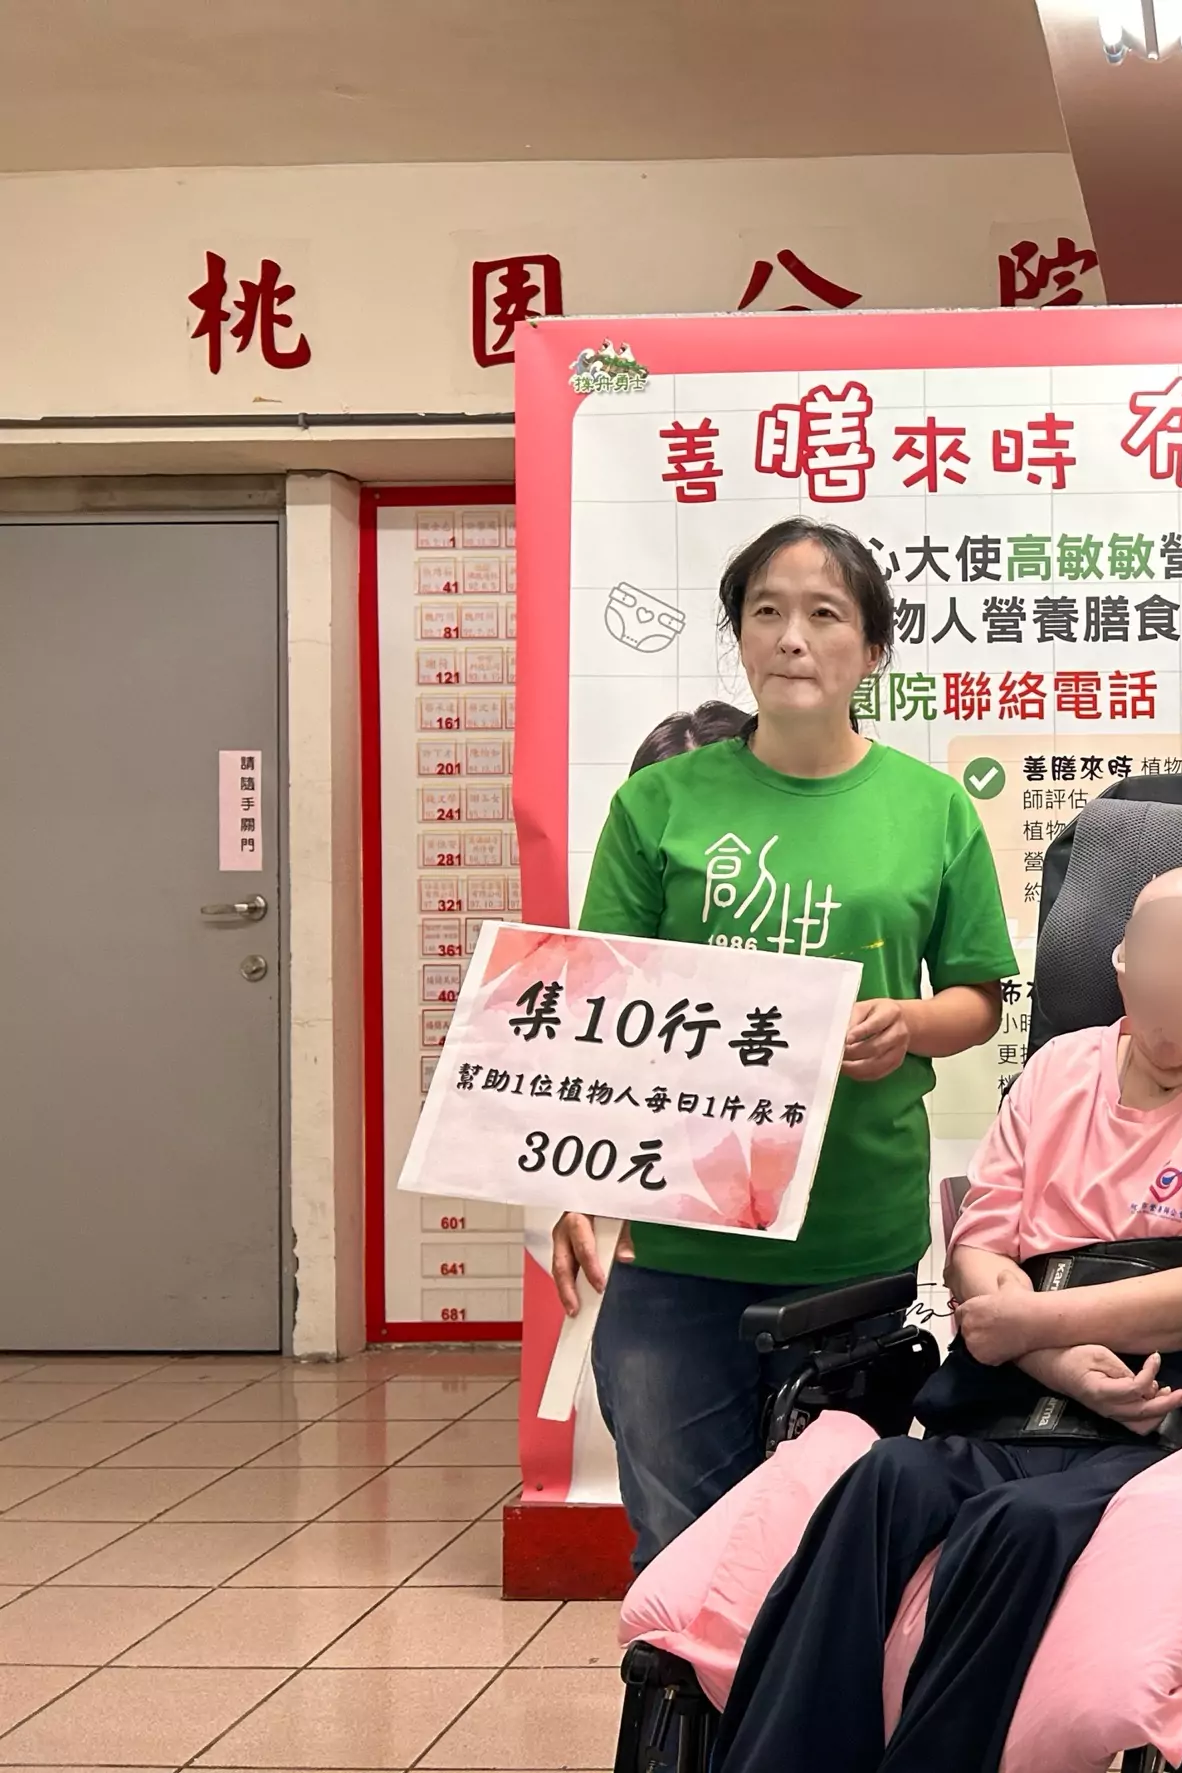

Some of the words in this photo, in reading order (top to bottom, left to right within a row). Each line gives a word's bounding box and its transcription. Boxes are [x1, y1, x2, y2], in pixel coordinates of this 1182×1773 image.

[659, 381, 1076, 503] 善膳來時
[443, 581, 459, 593] 41
[443, 626, 460, 639] 81
[436, 672, 460, 684] 121
[436, 717, 461, 730] 161
[436, 763, 461, 775] 201
[1022, 755, 1134, 782] 善膳來時
[240, 756, 256, 853] 請隨手關門
[1022, 789, 1089, 811] 師評估
[436, 808, 461, 821] 241
[437, 853, 462, 866] 281
[438, 899, 462, 912] 321
[438, 944, 462, 957] 361
[508, 980, 789, 1067] 集10行善
[455, 1063, 807, 1127] 幫助1位植物人每日1片尿布
[518, 1130, 667, 1190] 300元
[440, 1216, 466, 1229] 601
[440, 1262, 466, 1275] 641
[1049, 1262, 1067, 1291] kar
[441, 1308, 466, 1321] 681
